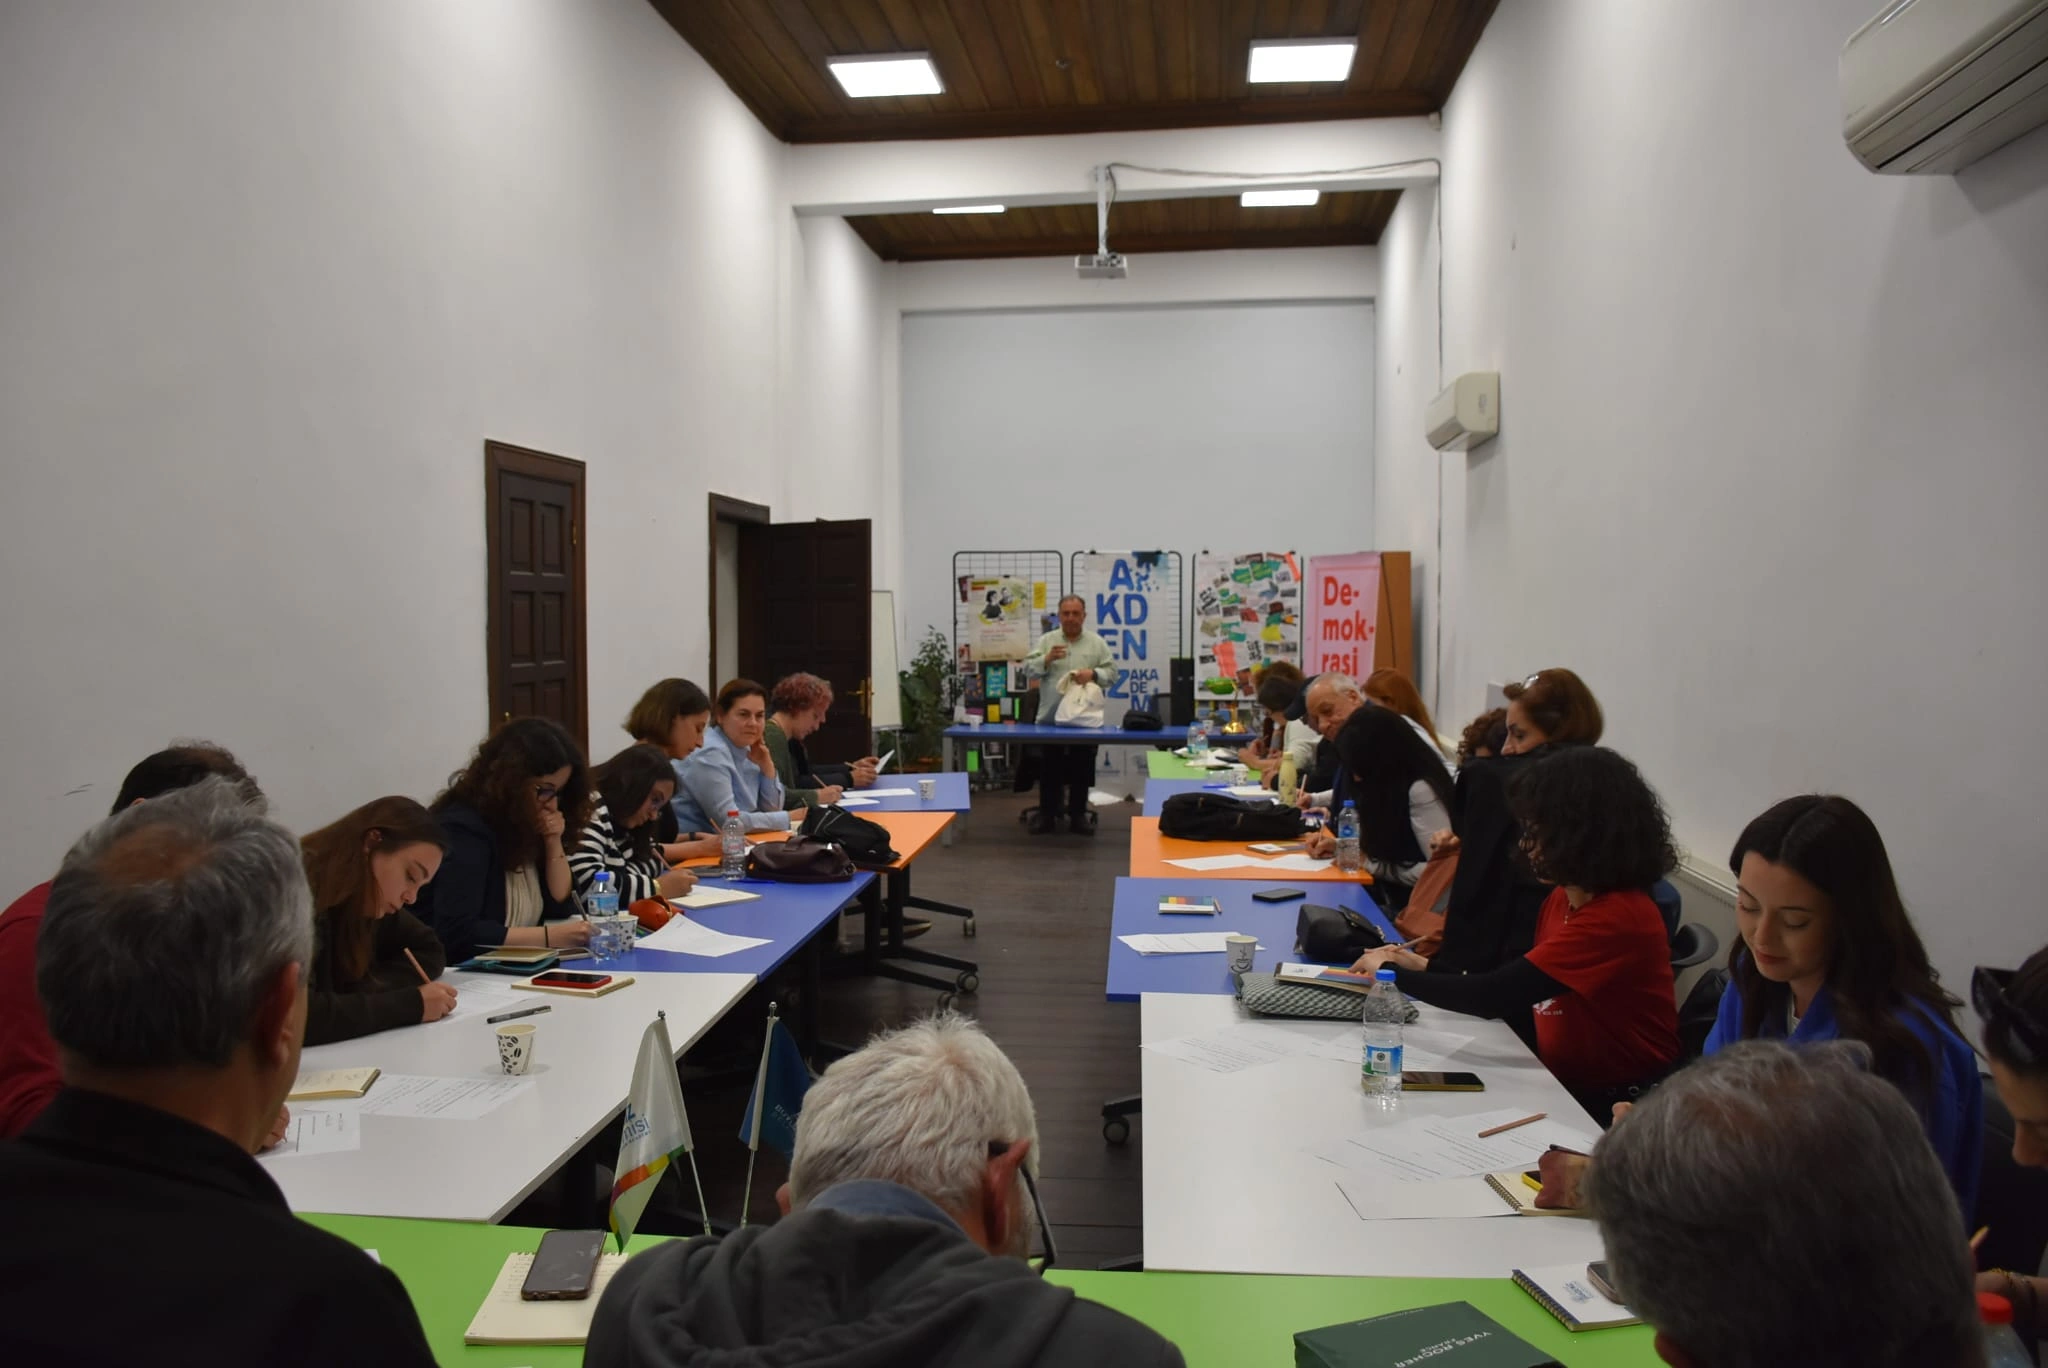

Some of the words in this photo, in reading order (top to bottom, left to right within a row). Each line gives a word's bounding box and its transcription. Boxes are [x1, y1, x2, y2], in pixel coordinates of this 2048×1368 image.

[1096, 593, 1149, 626] KD
[1322, 647, 1358, 677] rasi
[1103, 669, 1130, 699] Z
[1130, 668, 1159, 681] AKA
[1130, 682, 1148, 694] DE
[1456, 1331, 1492, 1346] YVES
[1394, 1344, 1454, 1368] ROCHER
